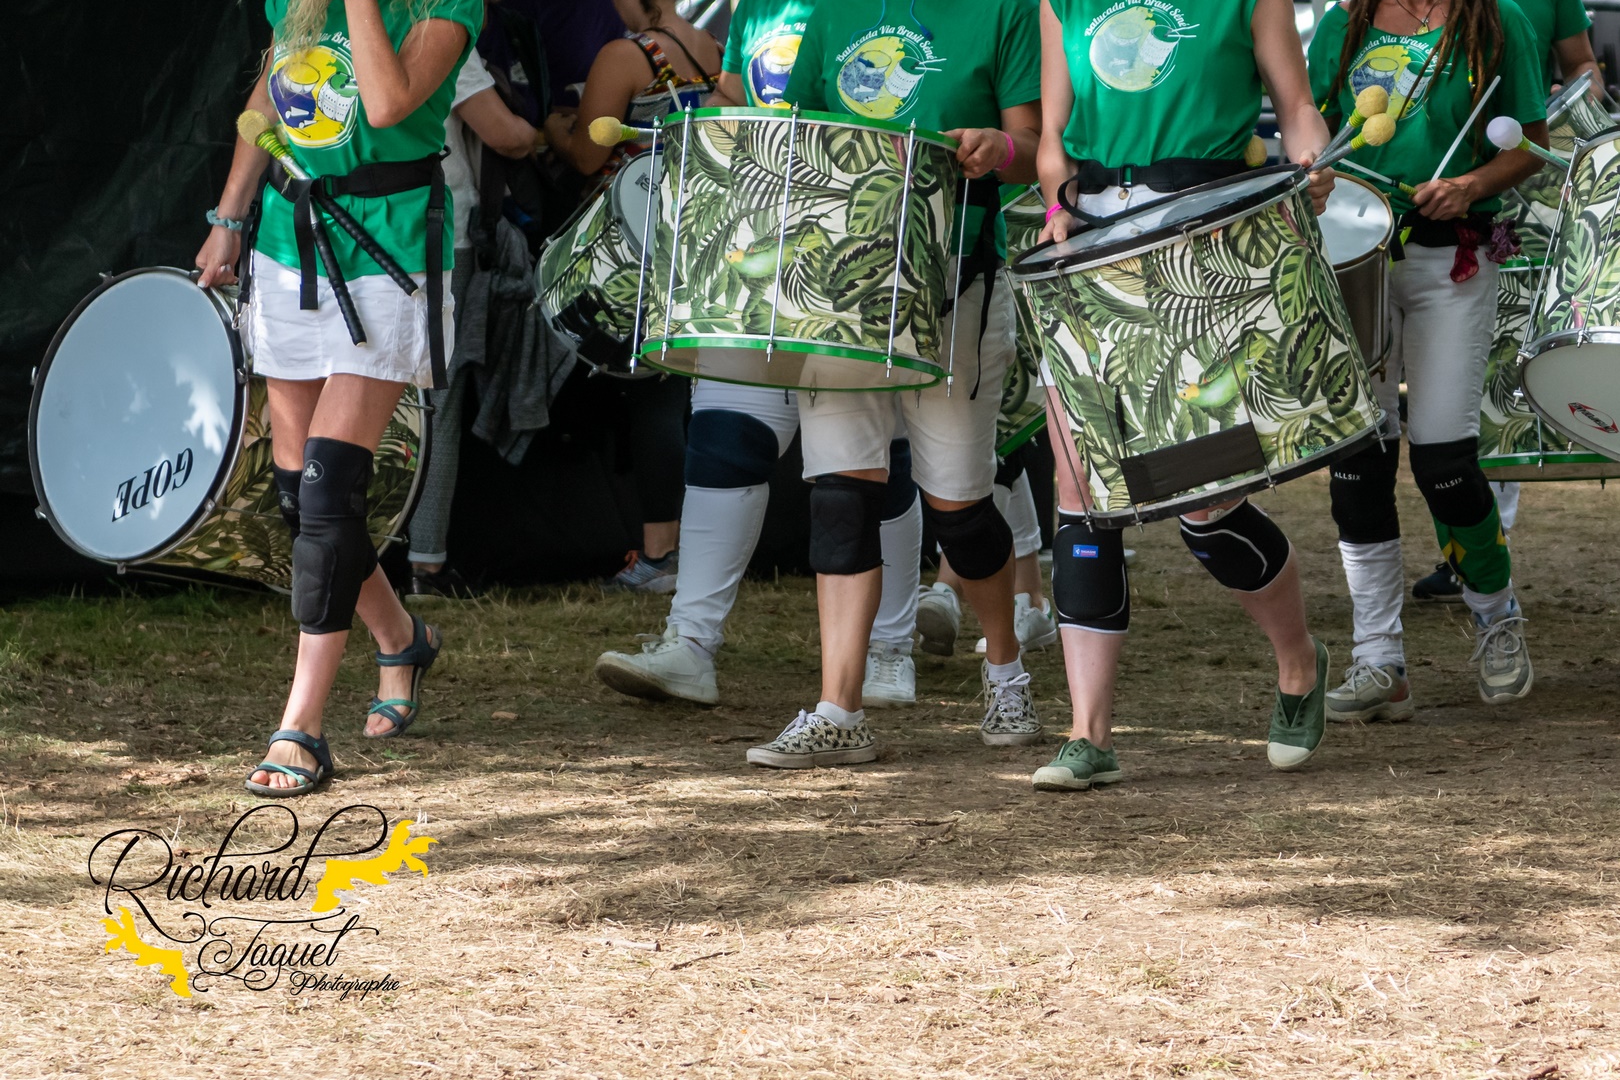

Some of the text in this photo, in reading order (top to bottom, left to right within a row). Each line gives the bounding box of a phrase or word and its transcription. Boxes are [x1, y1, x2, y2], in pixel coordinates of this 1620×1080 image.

[1084, 1, 1125, 36] Batucada
[1169, 8, 1190, 27] Séné
[835, 24, 939, 62] Batucada Via Brasil Séné
[1380, 34, 1397, 44] Via
[1400, 35, 1429, 52] Brasil
[112, 447, 194, 522] GOPE
[1334, 471, 1361, 481] ALLSIX
[1434, 476, 1463, 490] ALLSIX
